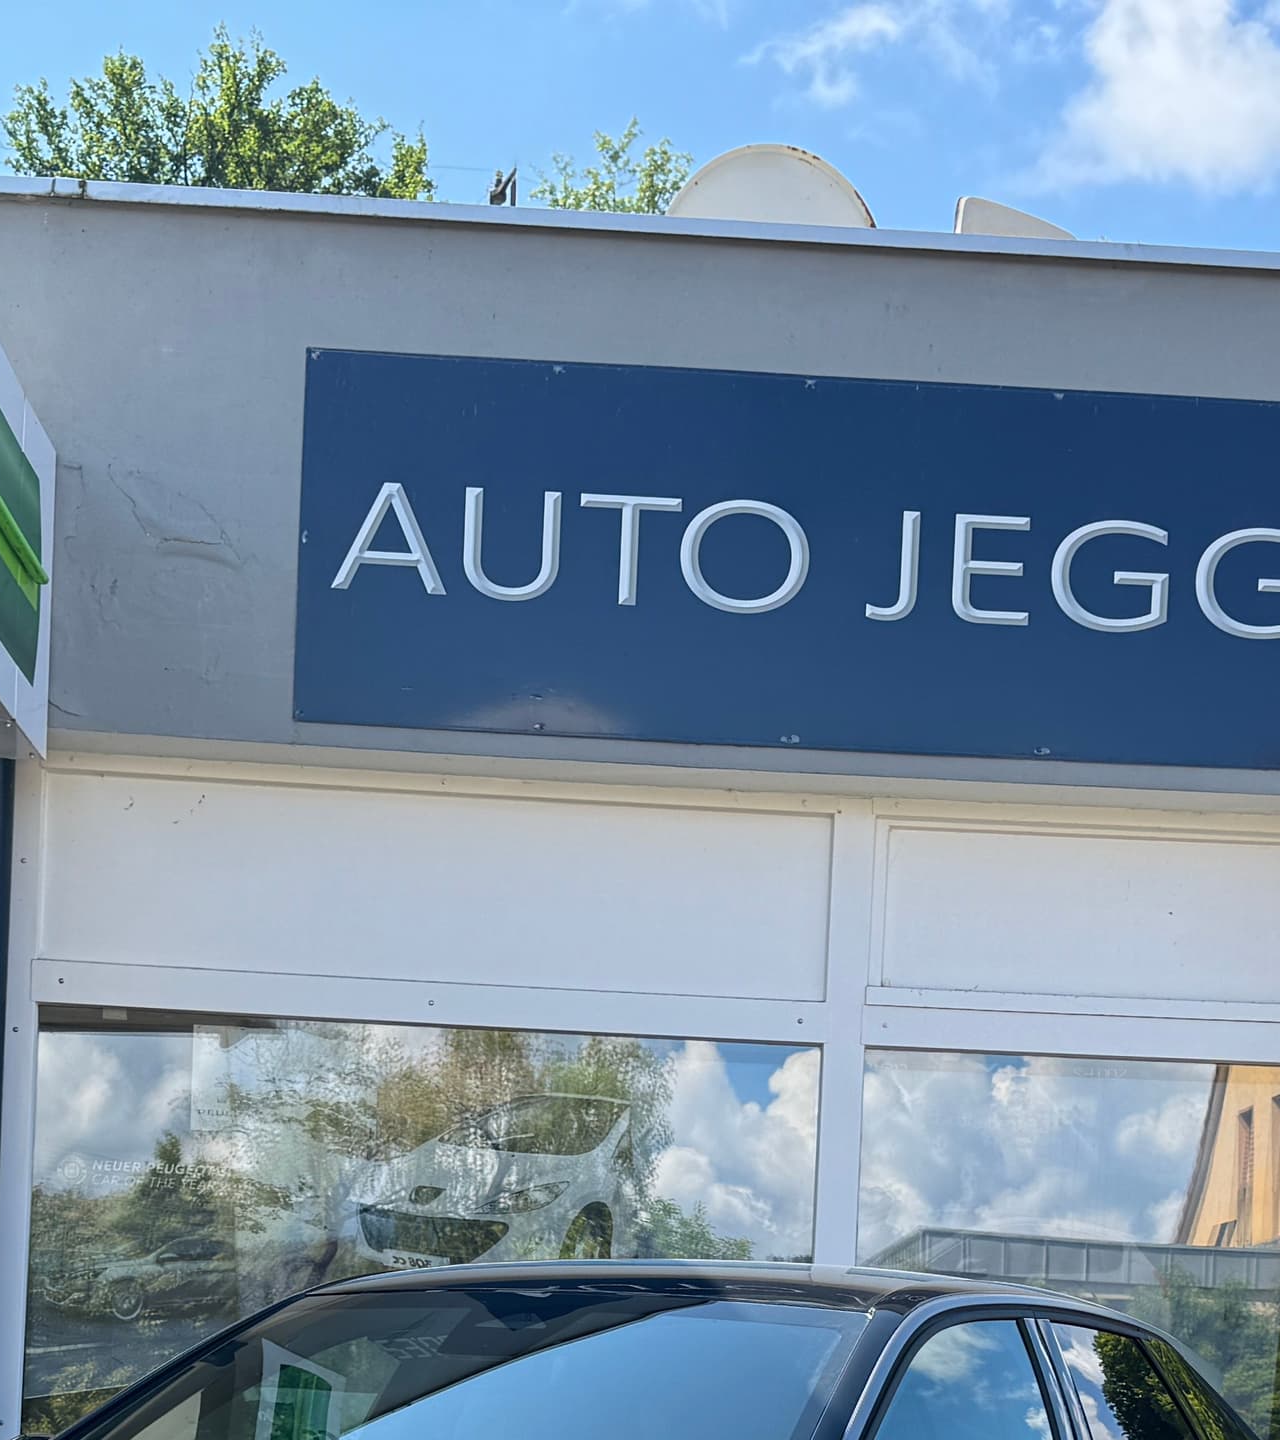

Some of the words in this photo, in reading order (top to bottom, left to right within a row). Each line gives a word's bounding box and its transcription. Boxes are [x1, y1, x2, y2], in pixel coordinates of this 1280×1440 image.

[330, 481, 810, 614] AUTO
[91, 1160, 141, 1174] NEUER
[91, 1173, 120, 1186] CAR
[124, 1175, 145, 1187] OF
[148, 1176, 176, 1190] THE
